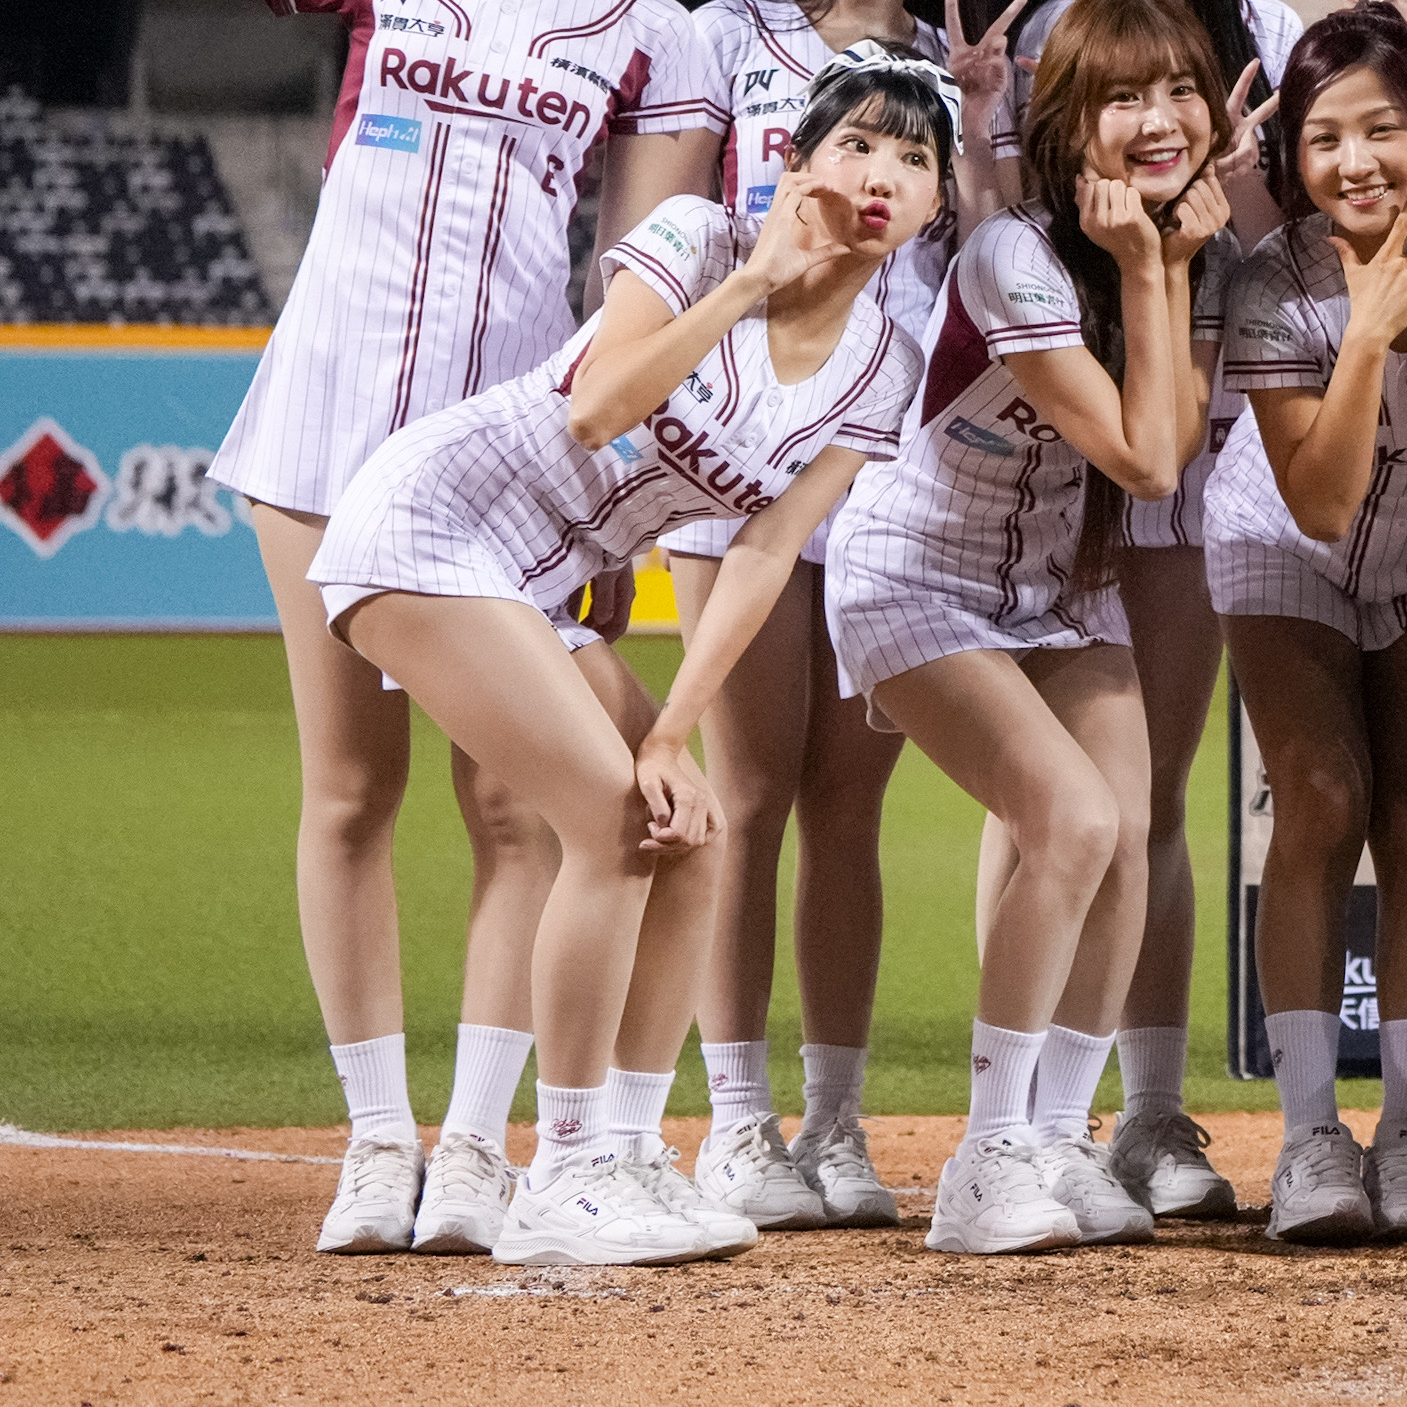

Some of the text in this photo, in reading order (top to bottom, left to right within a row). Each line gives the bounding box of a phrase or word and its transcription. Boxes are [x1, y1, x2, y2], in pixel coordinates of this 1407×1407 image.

[380, 47, 592, 140] Rakuten
[643, 397, 776, 515] akute
[1312, 1126, 1340, 1136] FILA
[591, 1153, 615, 1167] FILA
[970, 1183, 983, 1202] FILA
[576, 1197, 598, 1216] FILA
